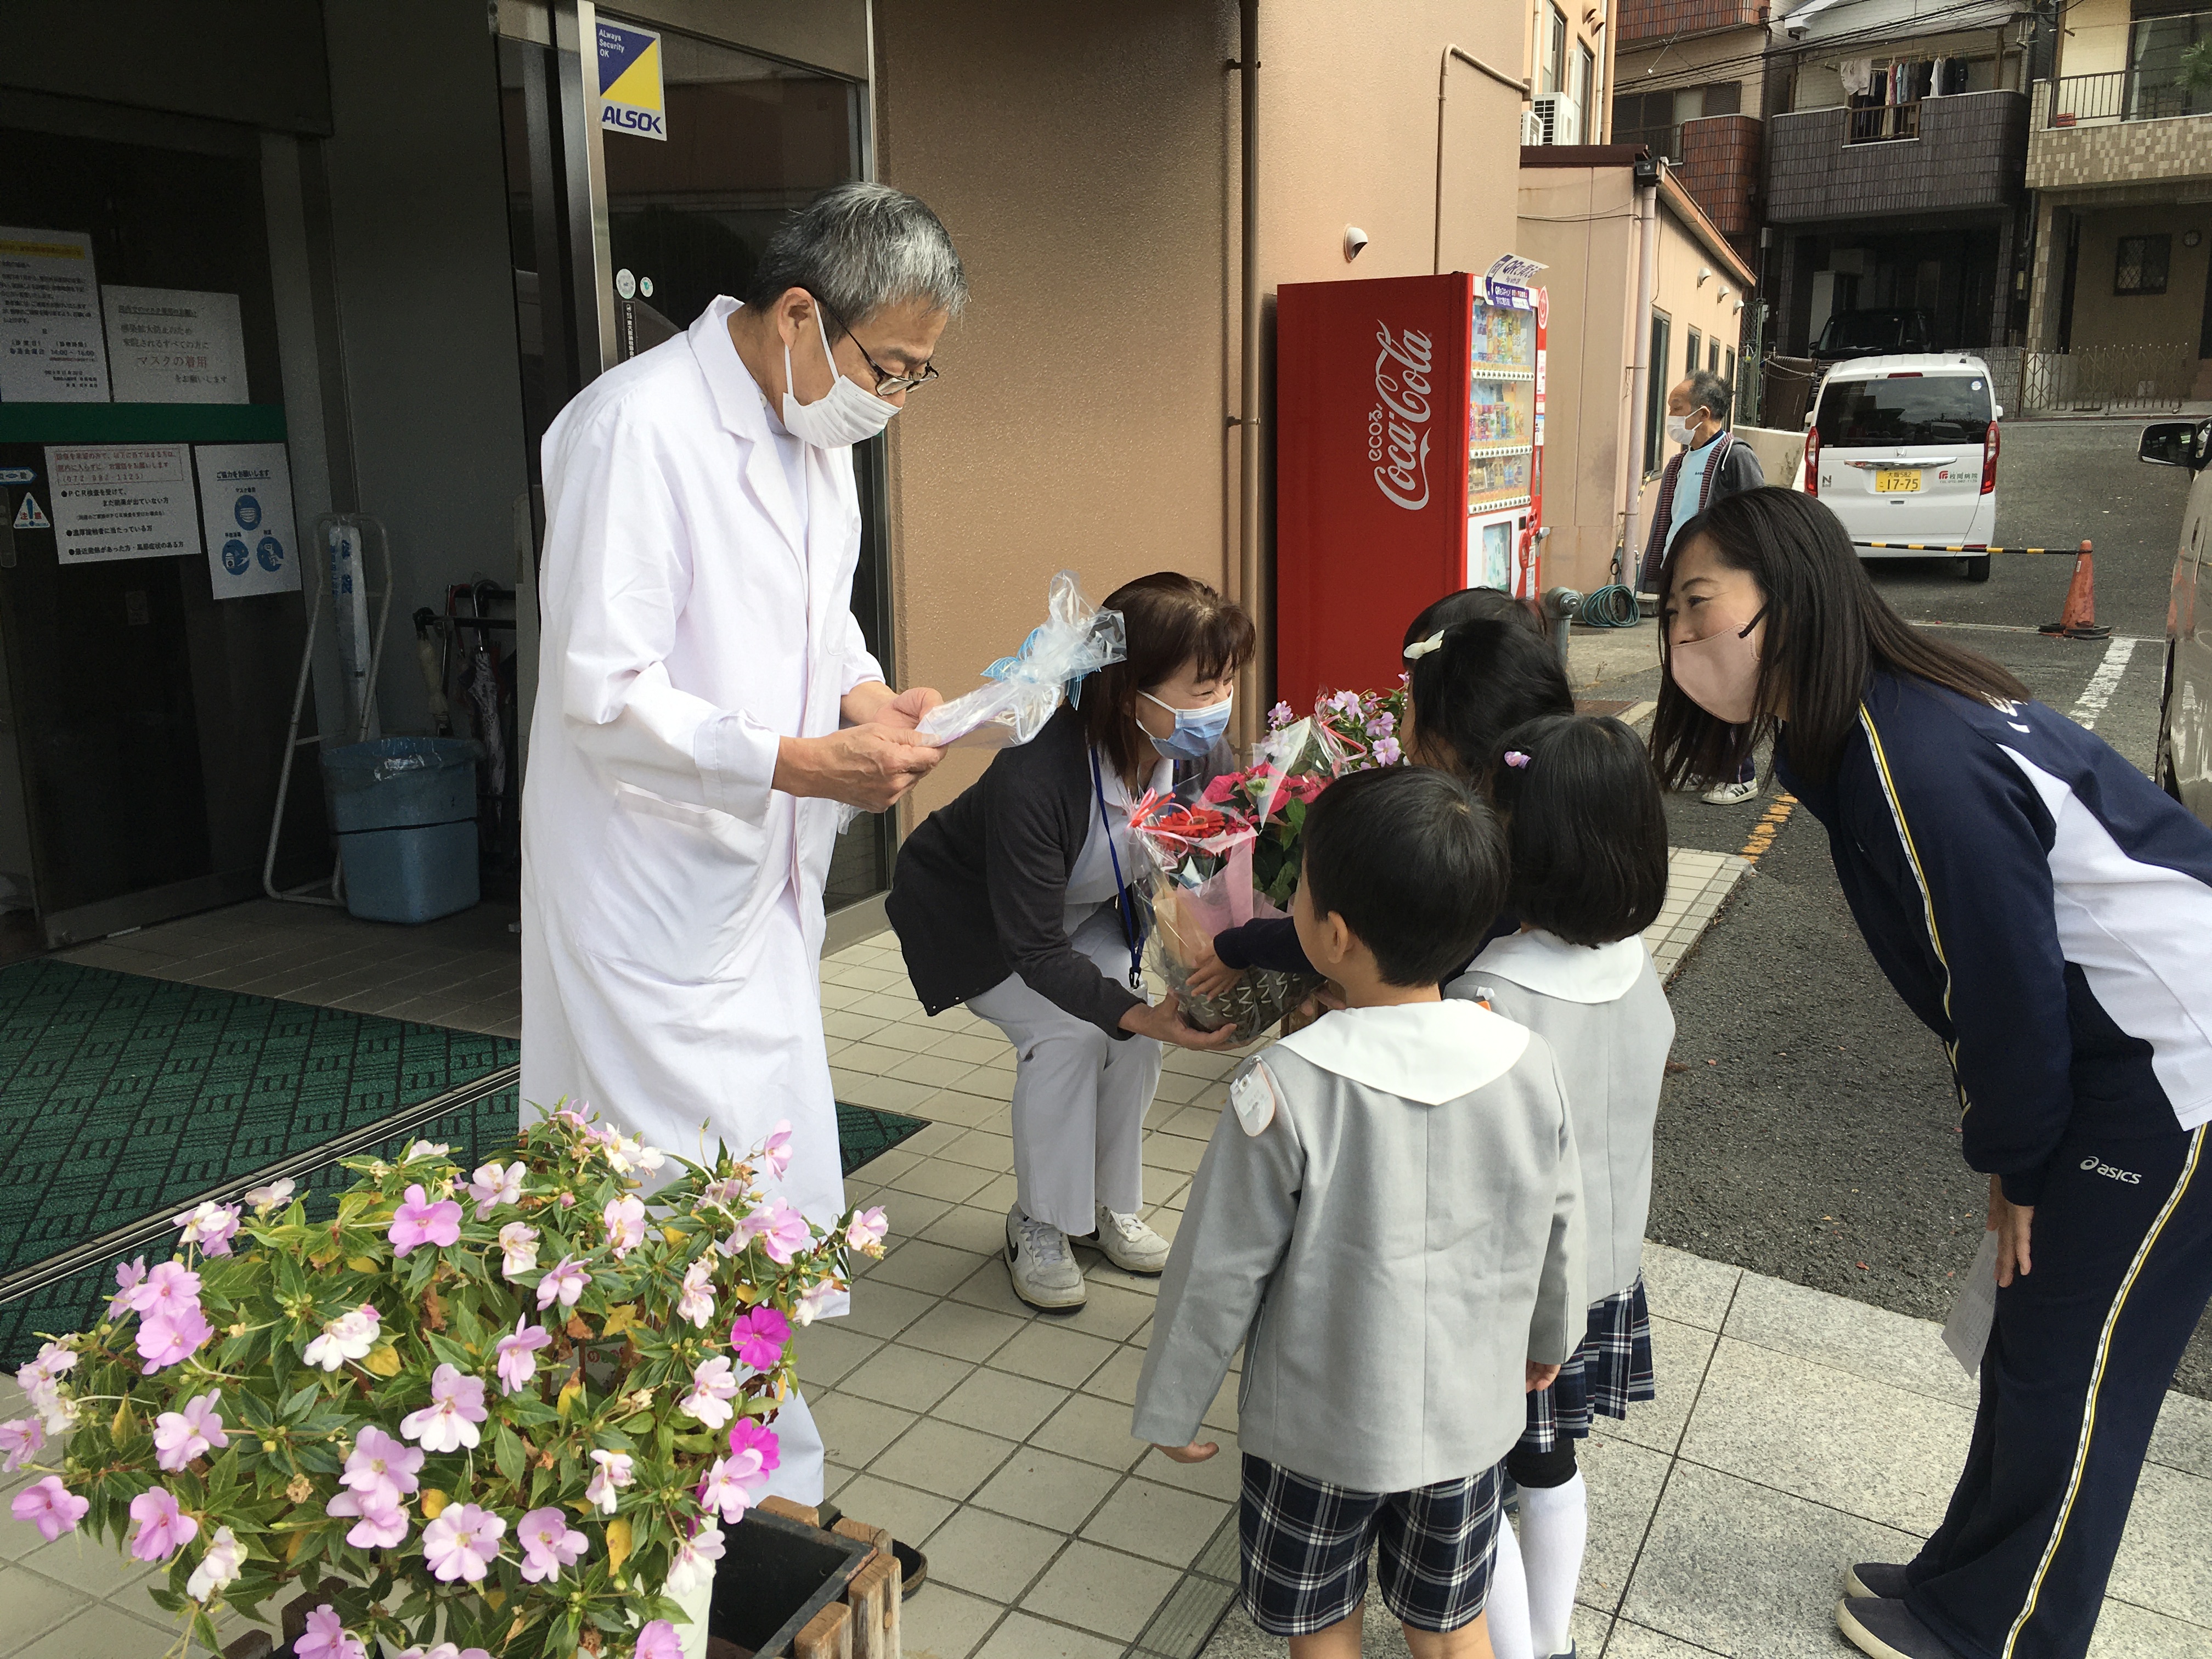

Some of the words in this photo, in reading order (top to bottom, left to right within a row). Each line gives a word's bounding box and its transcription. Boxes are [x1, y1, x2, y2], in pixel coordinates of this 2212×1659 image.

[599, 29, 622, 42] ALways
[599, 38, 624, 53] Security
[600, 49, 610, 58] OK
[602, 106, 662, 134] ALSOK
[137, 355, 207, 369] マスクの着用
[174, 374, 228, 384] をお願いします
[1374, 319, 1432, 510] Coca-Cola
[216, 469, 270, 479] ご協力をお願いします
[1822, 475, 1832, 483] N
[1887, 478, 1918, 490] 17-75
[103, 497, 170, 507] まだ結果が出ていない方
[2097, 1163, 2142, 1184] asics
